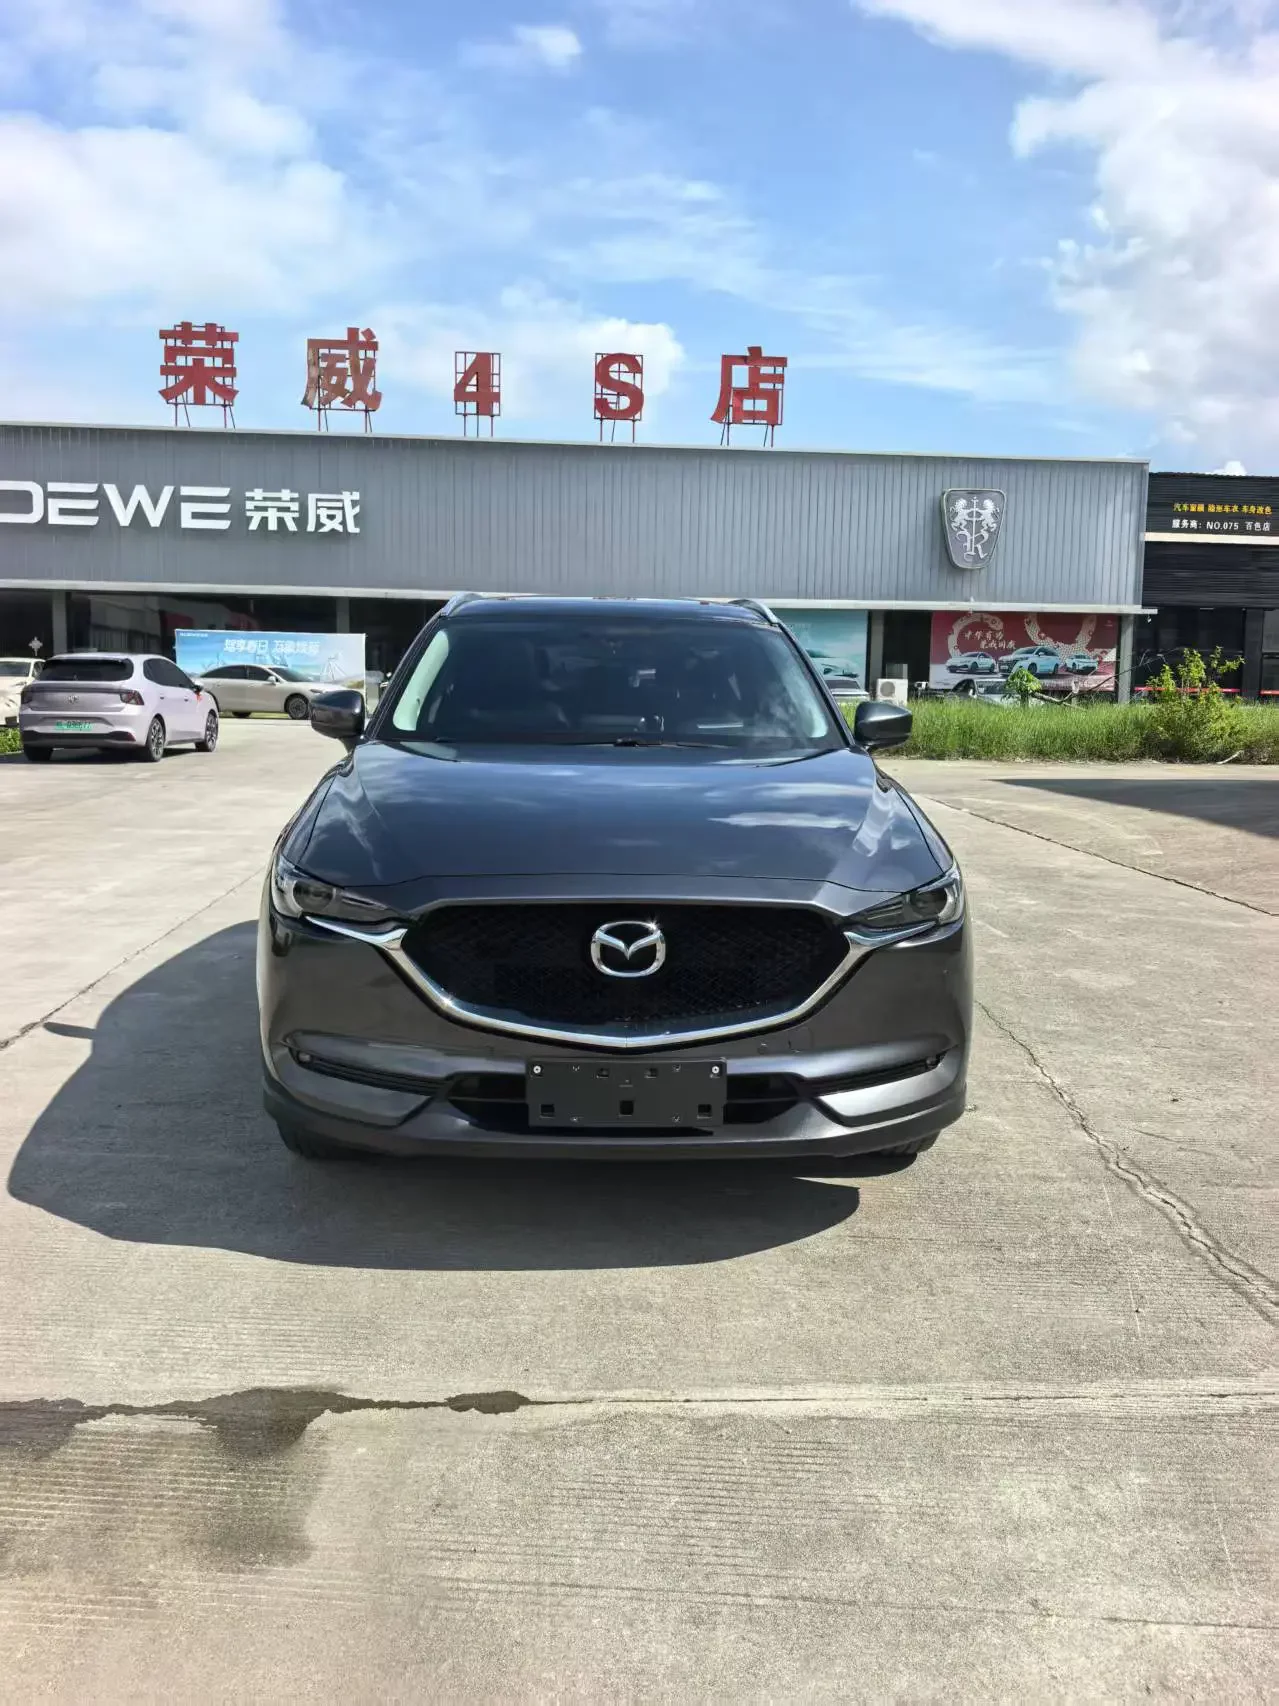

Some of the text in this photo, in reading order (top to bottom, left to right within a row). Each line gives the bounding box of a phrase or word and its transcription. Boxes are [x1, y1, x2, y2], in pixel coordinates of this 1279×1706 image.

[159, 321, 788, 426] 荣威4S店
[245, 488, 361, 534] 荣威
[1206, 521, 1239, 530] NO.075
[1245, 521, 1271, 531] 百色店
